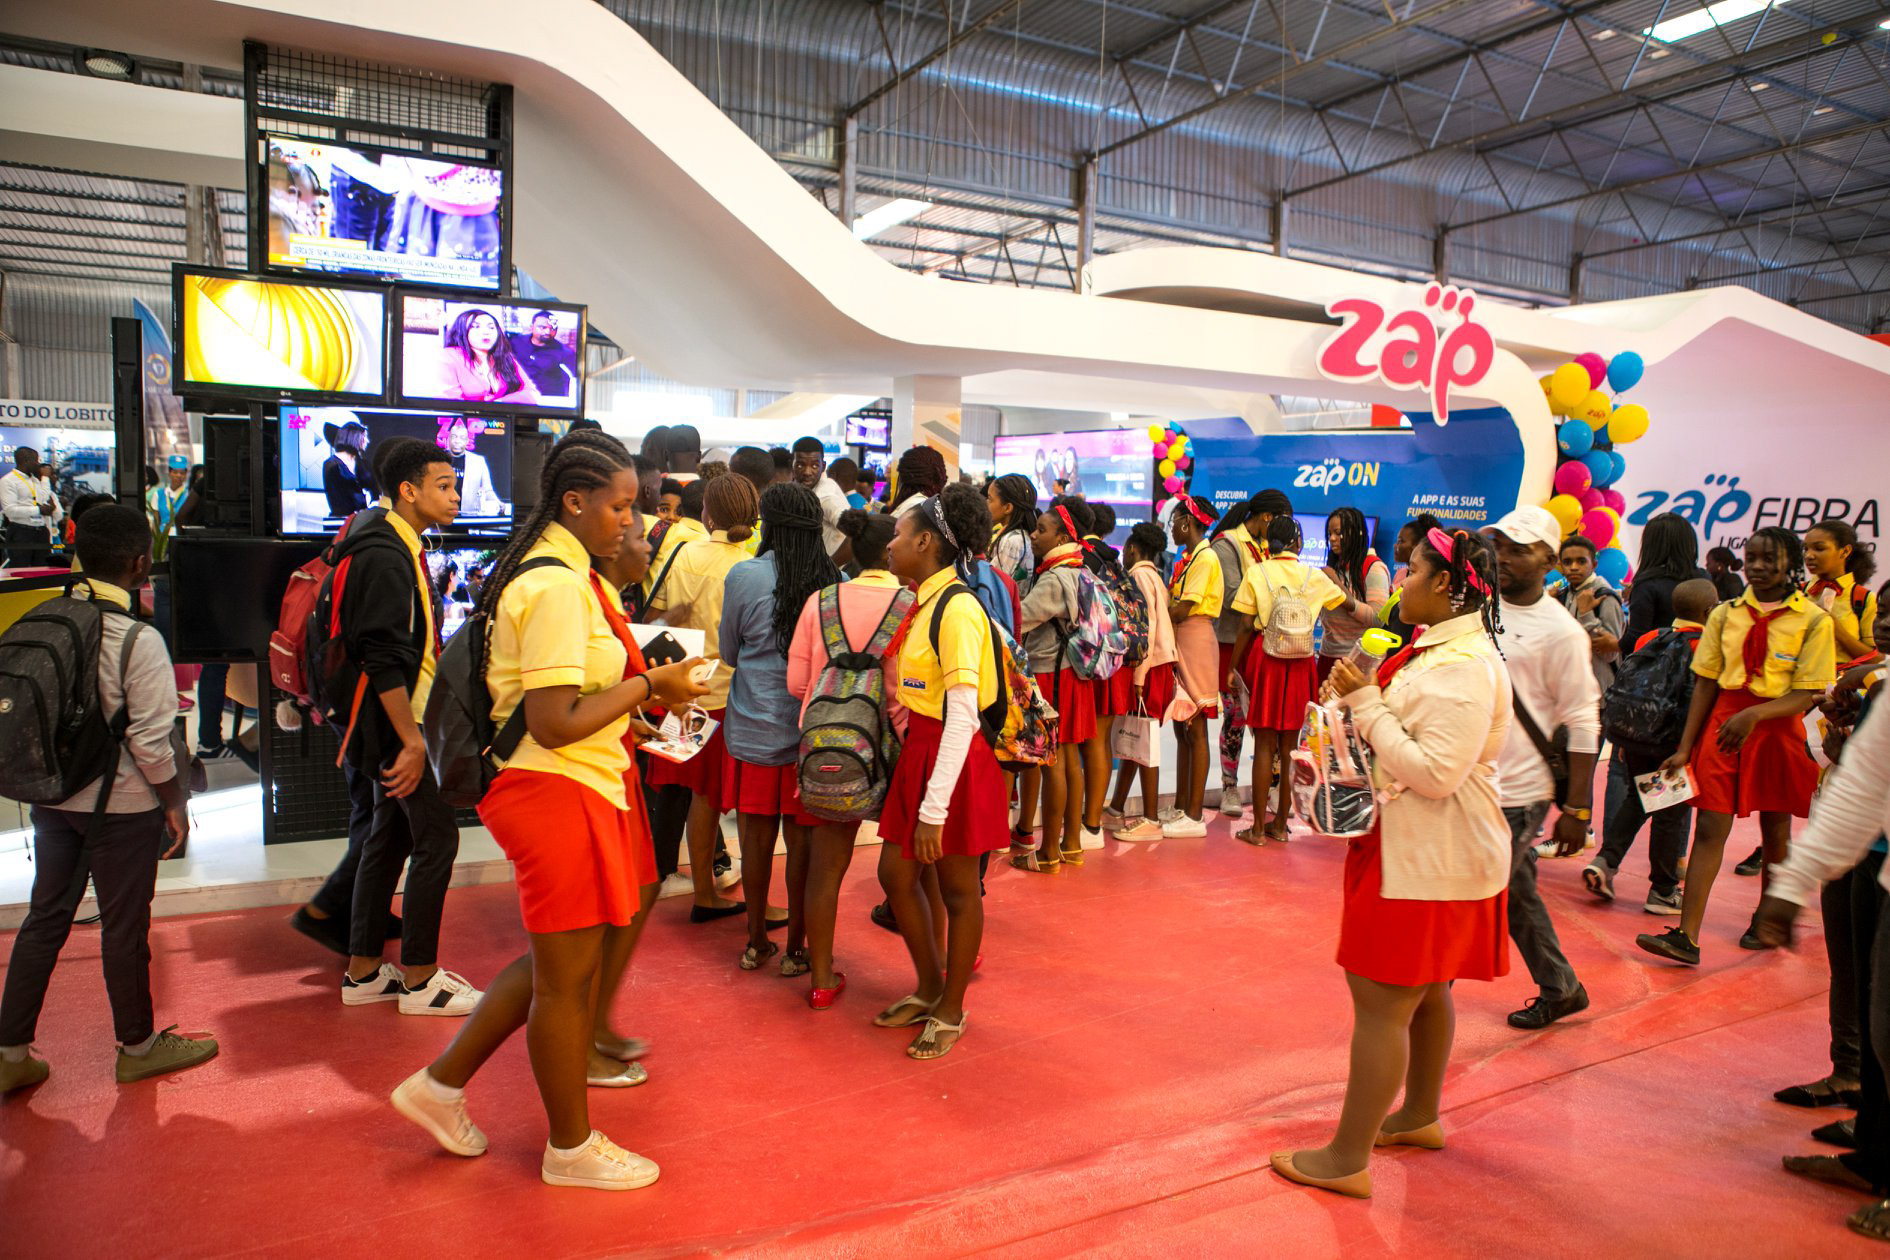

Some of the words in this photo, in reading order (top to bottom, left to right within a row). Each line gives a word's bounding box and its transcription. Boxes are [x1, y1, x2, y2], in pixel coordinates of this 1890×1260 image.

[24, 405, 51, 419] DO
[1347, 462, 1380, 486] ON
[1215, 490, 1248, 500] DESCUBRA
[1412, 494, 1419, 504] A
[1420, 494, 1439, 505] APP
[1439, 496, 1446, 506] E
[1446, 496, 1459, 506] AS
[1460, 496, 1486, 507] SUAS
